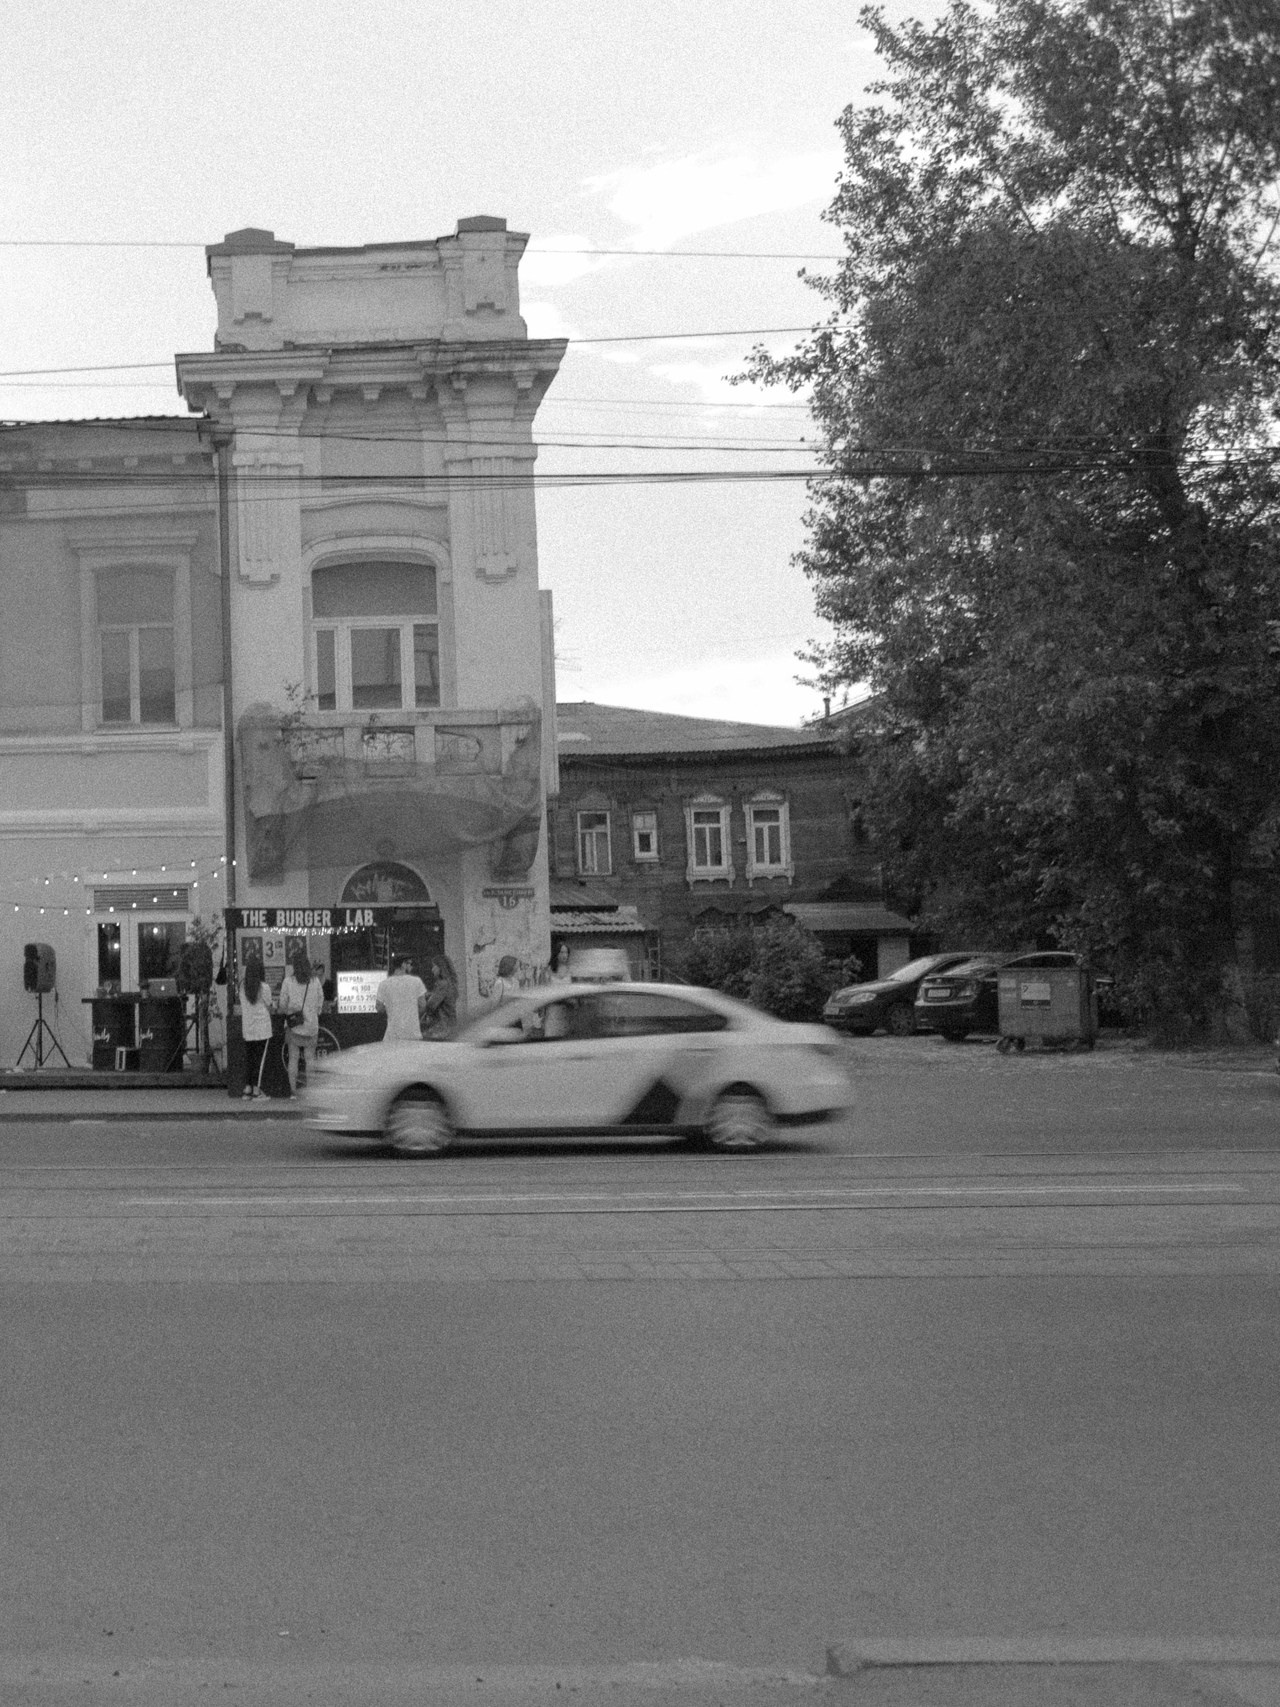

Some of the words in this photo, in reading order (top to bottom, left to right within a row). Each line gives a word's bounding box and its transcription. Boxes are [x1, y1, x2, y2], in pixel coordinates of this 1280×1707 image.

[503, 896, 516, 907] 16
[241, 910, 268, 927] THE
[276, 910, 331, 927] BURGER
[345, 909, 377, 927] LAB.
